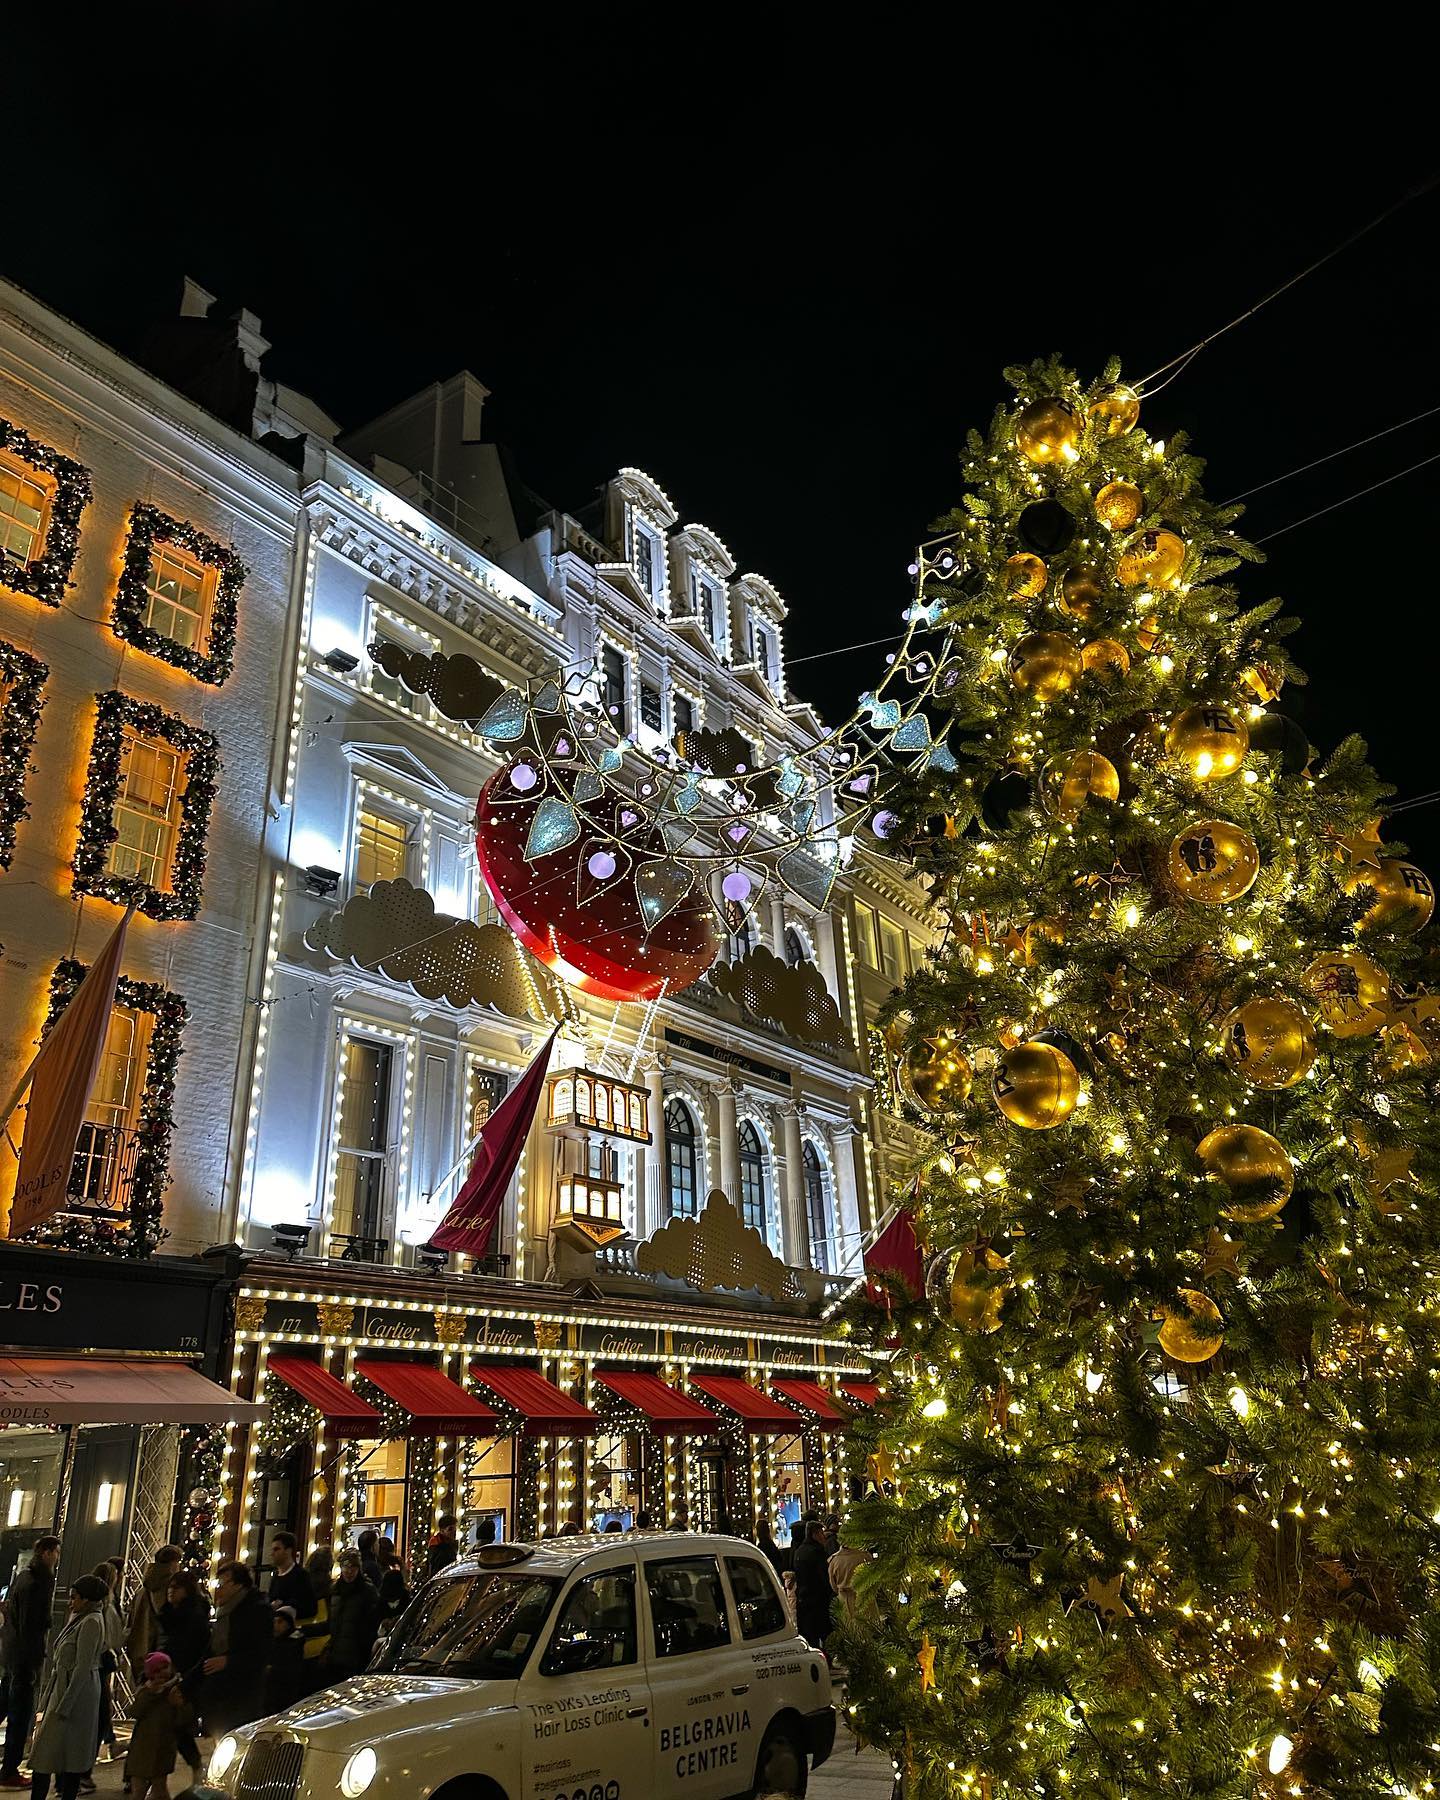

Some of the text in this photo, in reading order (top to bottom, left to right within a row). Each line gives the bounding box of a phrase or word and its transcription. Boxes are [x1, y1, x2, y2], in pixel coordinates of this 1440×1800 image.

[712, 1046, 743, 1066] Cartier
[443, 1207, 491, 1231] Carter
[279, 1318, 301, 1332] 177
[366, 1316, 420, 1339] Cartier
[476, 1324, 522, 1345] Cartier
[179, 1336, 198, 1347] 178
[600, 1333, 645, 1355] Cartier
[693, 1340, 730, 1360] Cartier
[732, 1346, 744, 1357] 175
[772, 1346, 804, 1364] Cartier
[334, 1423, 367, 1434] Cartier
[770, 1664, 786, 1677] 7730
[526, 1687, 632, 1717] The UK's Leading
[533, 1705, 625, 1739] Hair Loss Clinic
[660, 1709, 751, 1751] BELGRAVIA
[676, 1741, 738, 1778] CENTRE
